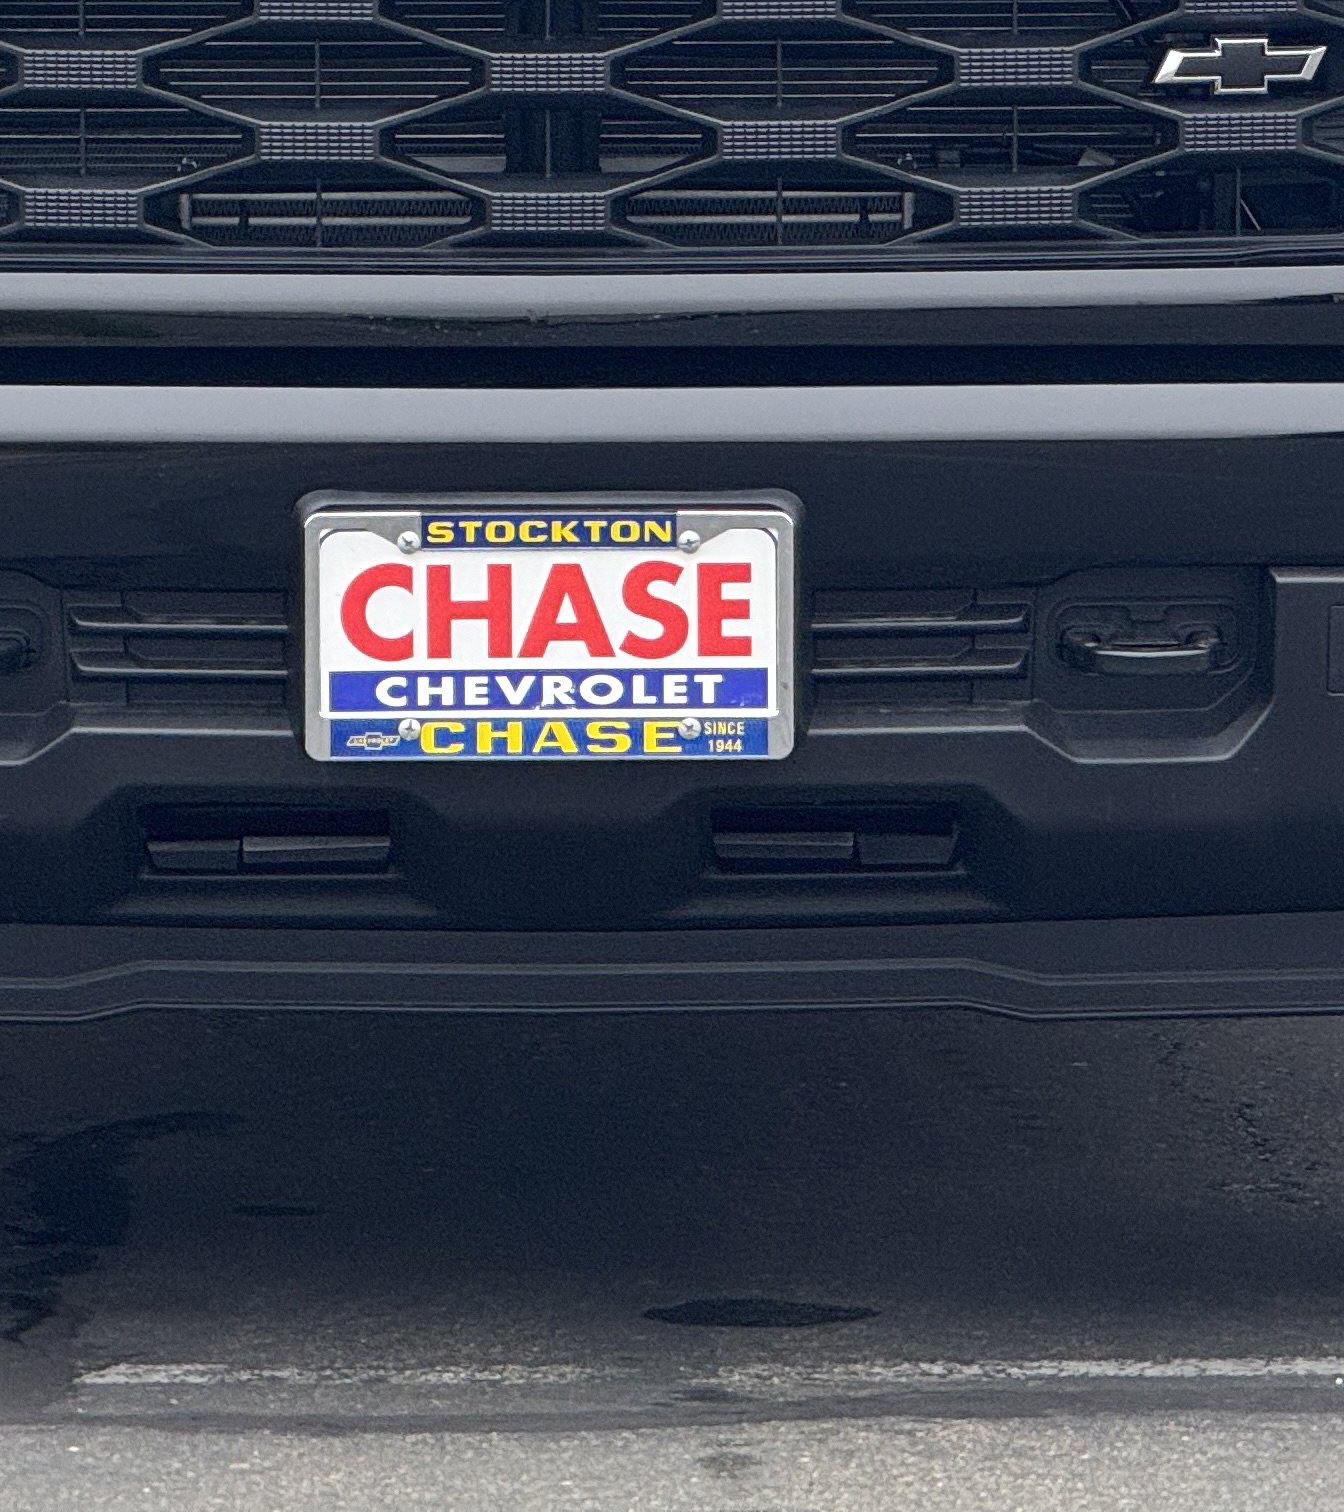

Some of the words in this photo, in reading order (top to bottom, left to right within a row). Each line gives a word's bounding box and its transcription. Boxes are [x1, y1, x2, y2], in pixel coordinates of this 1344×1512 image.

[426, 521, 672, 543] STOCKTON
[340, 560, 753, 662] CHASE
[375, 675, 724, 707] CHEVROLET
[420, 721, 683, 754] CHASE
[703, 721, 745, 736] SINCE
[708, 738, 743, 753] 1944
